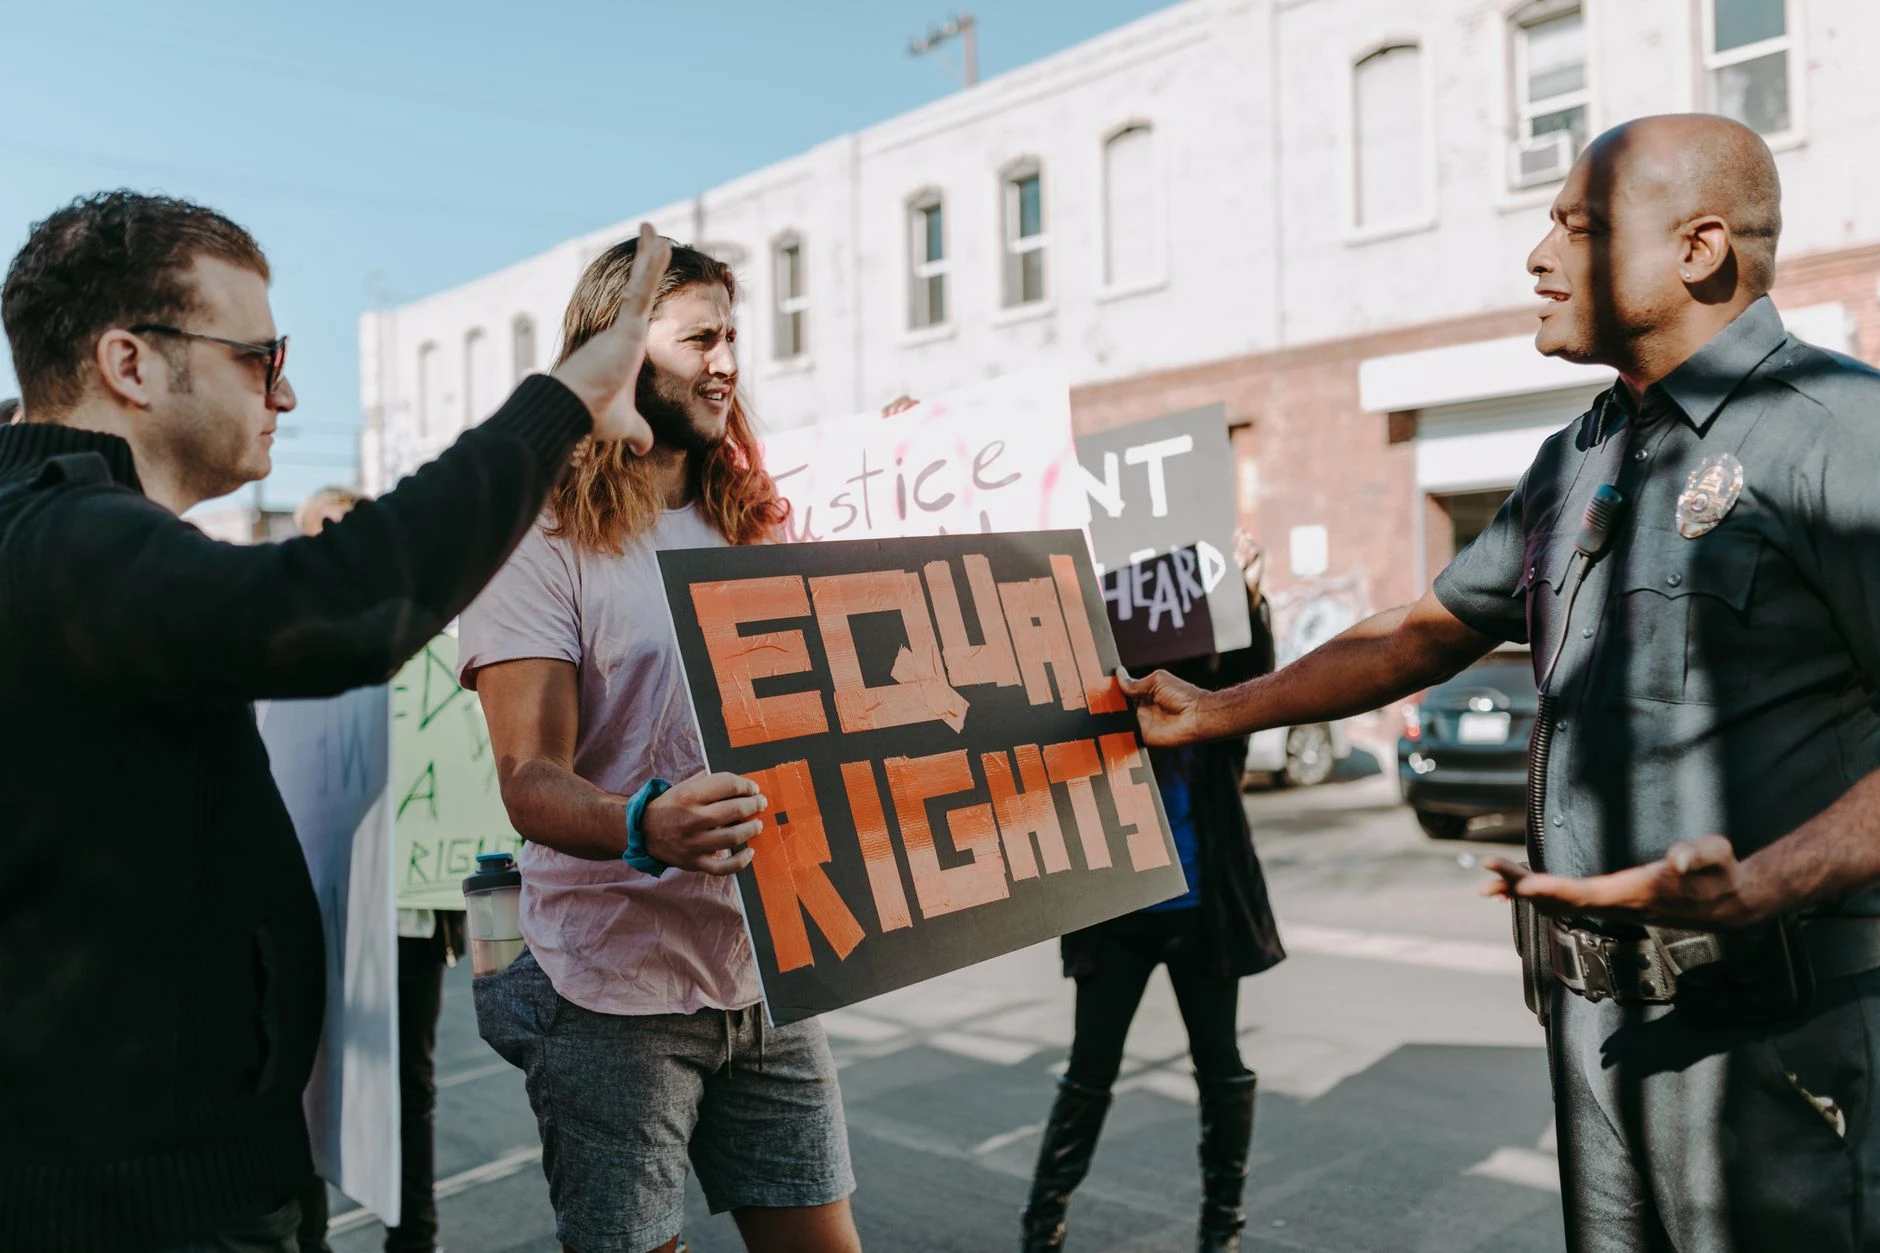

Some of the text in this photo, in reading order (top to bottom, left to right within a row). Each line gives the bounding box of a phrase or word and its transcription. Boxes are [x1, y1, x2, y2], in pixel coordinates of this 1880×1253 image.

[689, 554, 1128, 748] EQUAL
[1096, 540, 1226, 632] HEARD
[394, 643, 462, 732] D
[739, 732, 1171, 973] RIGHTS
